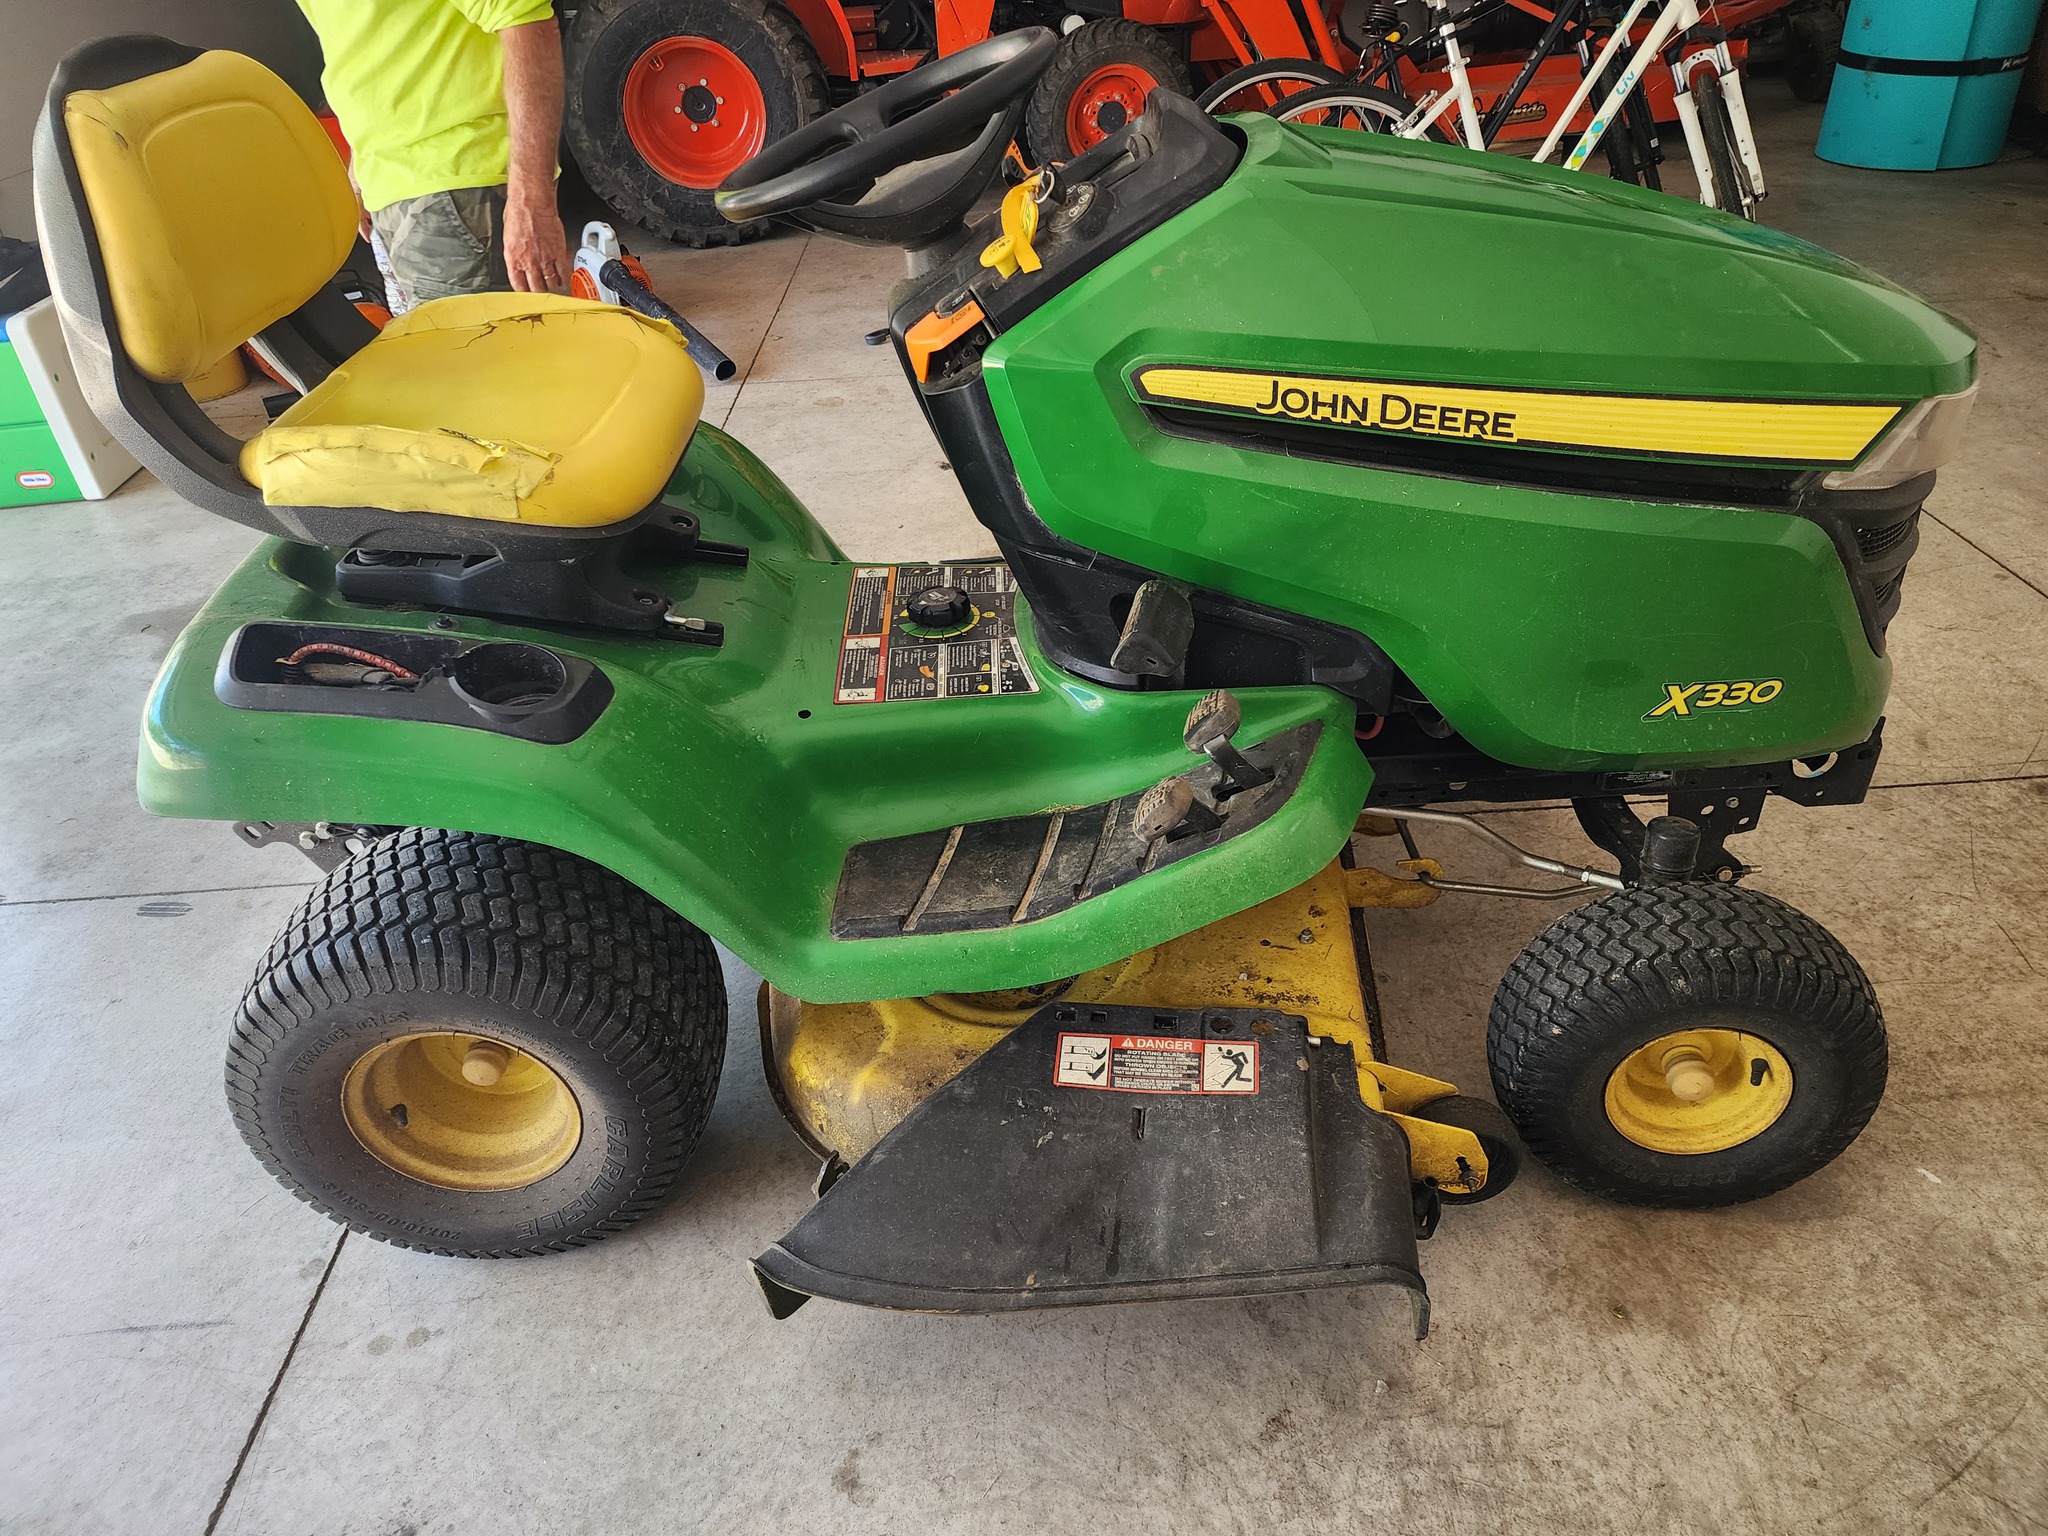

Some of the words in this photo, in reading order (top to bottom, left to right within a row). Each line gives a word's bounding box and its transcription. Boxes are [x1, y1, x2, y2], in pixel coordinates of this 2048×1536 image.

[1615, 69, 1635, 96] Liv
[1256, 380, 1369, 422] JOHN
[1380, 393, 1517, 438] DEERE
[1648, 679, 1783, 716] X330
[1136, 1038, 1193, 1051] DANGER
[515, 1115, 629, 1240] CARLISLE
